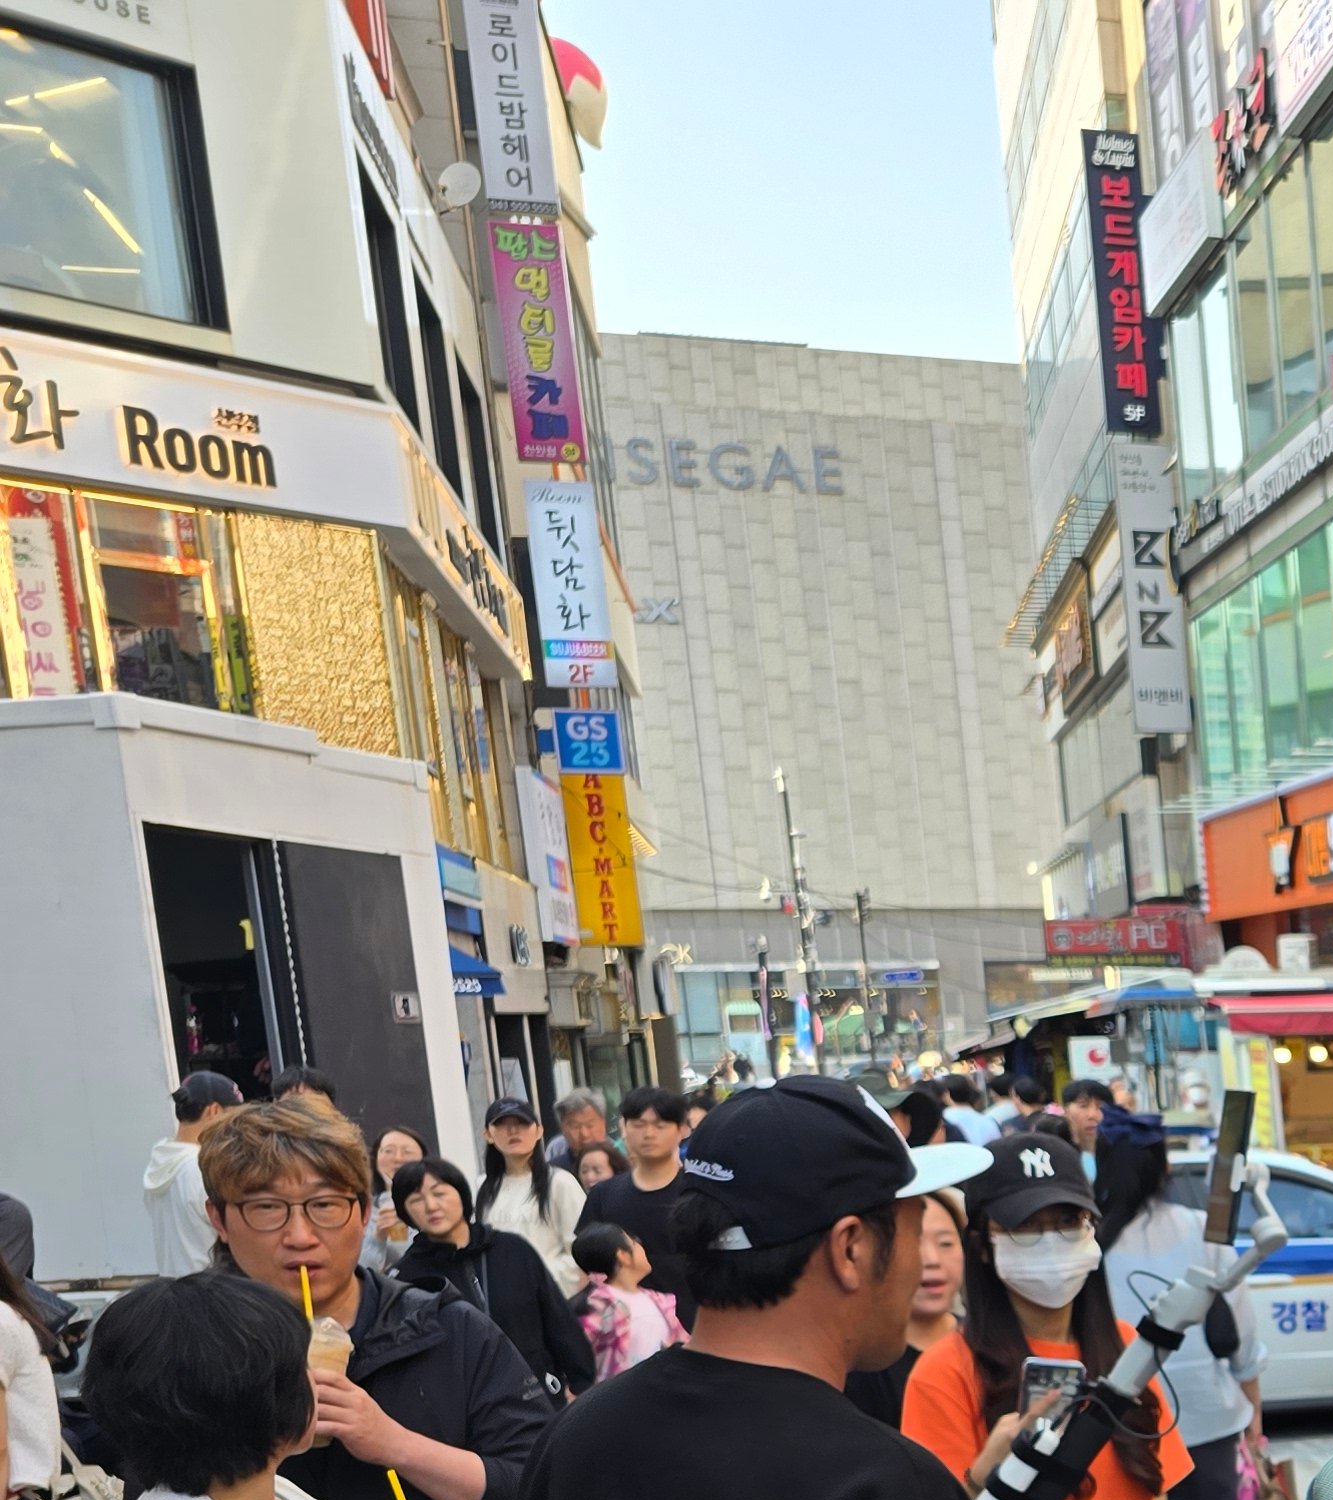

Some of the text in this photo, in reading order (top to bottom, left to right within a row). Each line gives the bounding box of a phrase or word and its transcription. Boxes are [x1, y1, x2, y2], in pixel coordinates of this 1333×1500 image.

[488, 13, 533, 196] 로이드밤헤어
[1100, 174, 1149, 399] 보드게임카페
[1123, 403, 1146, 423] 5F
[120, 404, 278, 488] Room
[601, 432, 845, 496] SEGAE
[544, 509, 592, 632] 뒷담화
[568, 663, 595, 684] 2F
[566, 715, 608, 741] GS
[571, 741, 611, 766] 25
[1129, 920, 1168, 951] PC
[1271, 1301, 1329, 1334] 경찰
